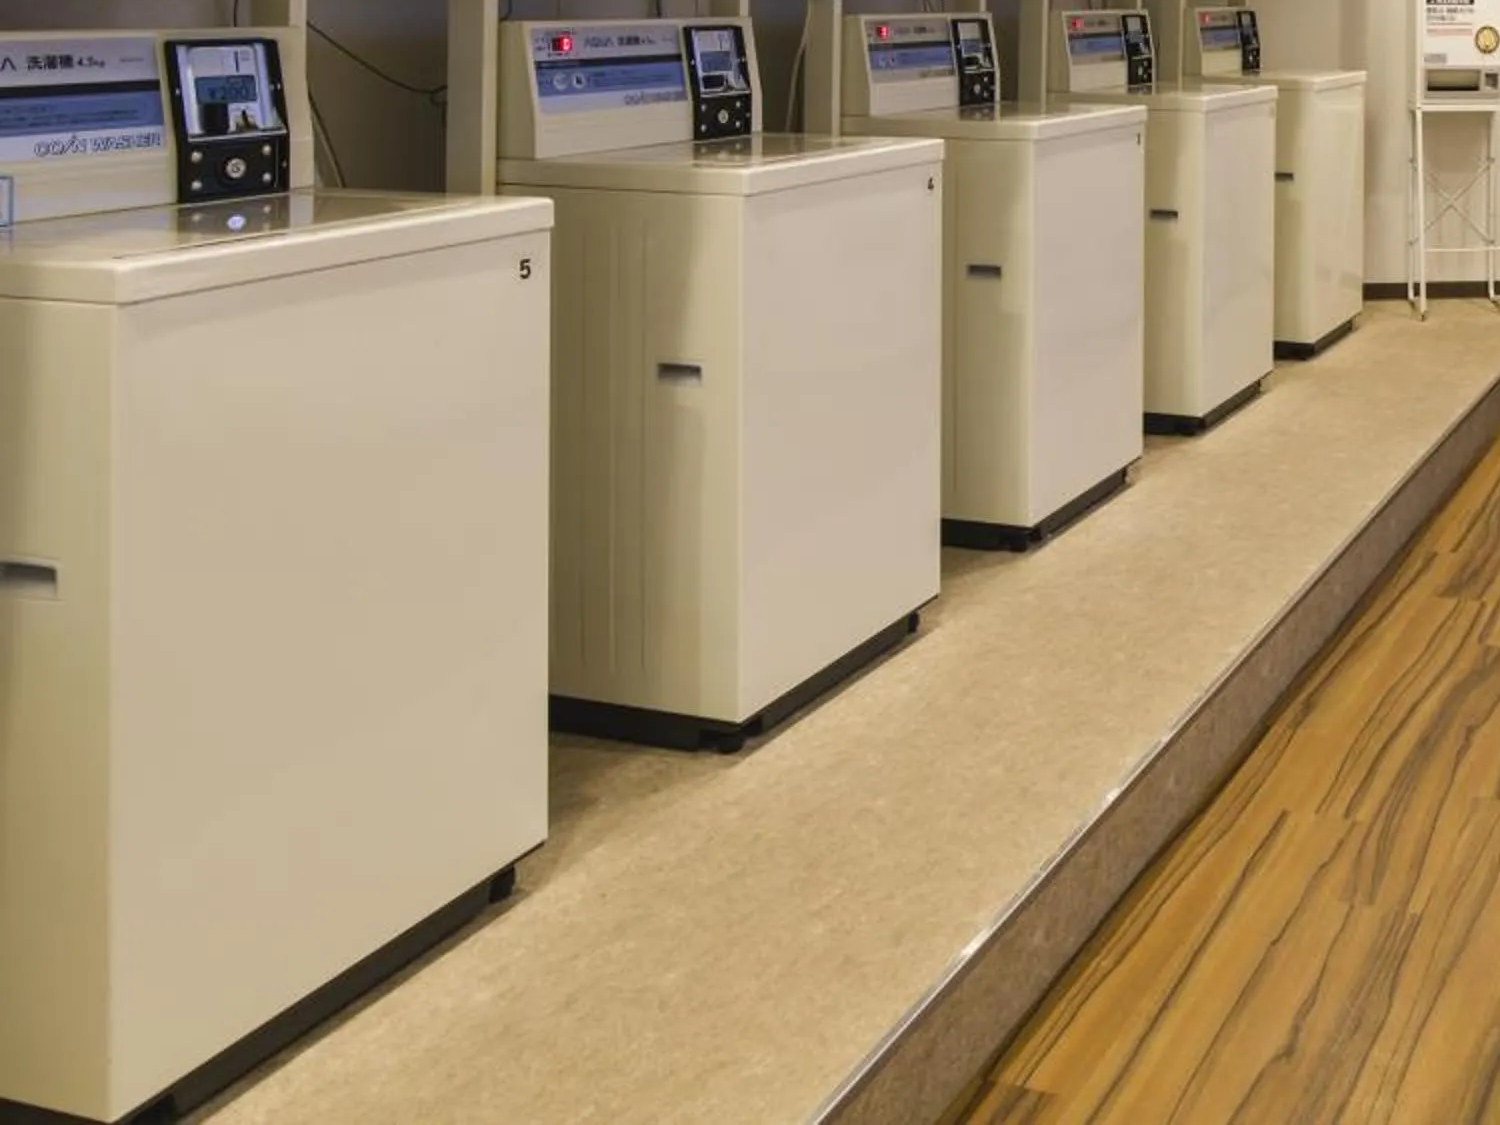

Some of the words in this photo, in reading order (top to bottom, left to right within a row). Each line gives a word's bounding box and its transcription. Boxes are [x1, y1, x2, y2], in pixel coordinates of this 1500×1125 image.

[26, 53, 75, 71] 洗濯機
[518, 258, 532, 280] 5
